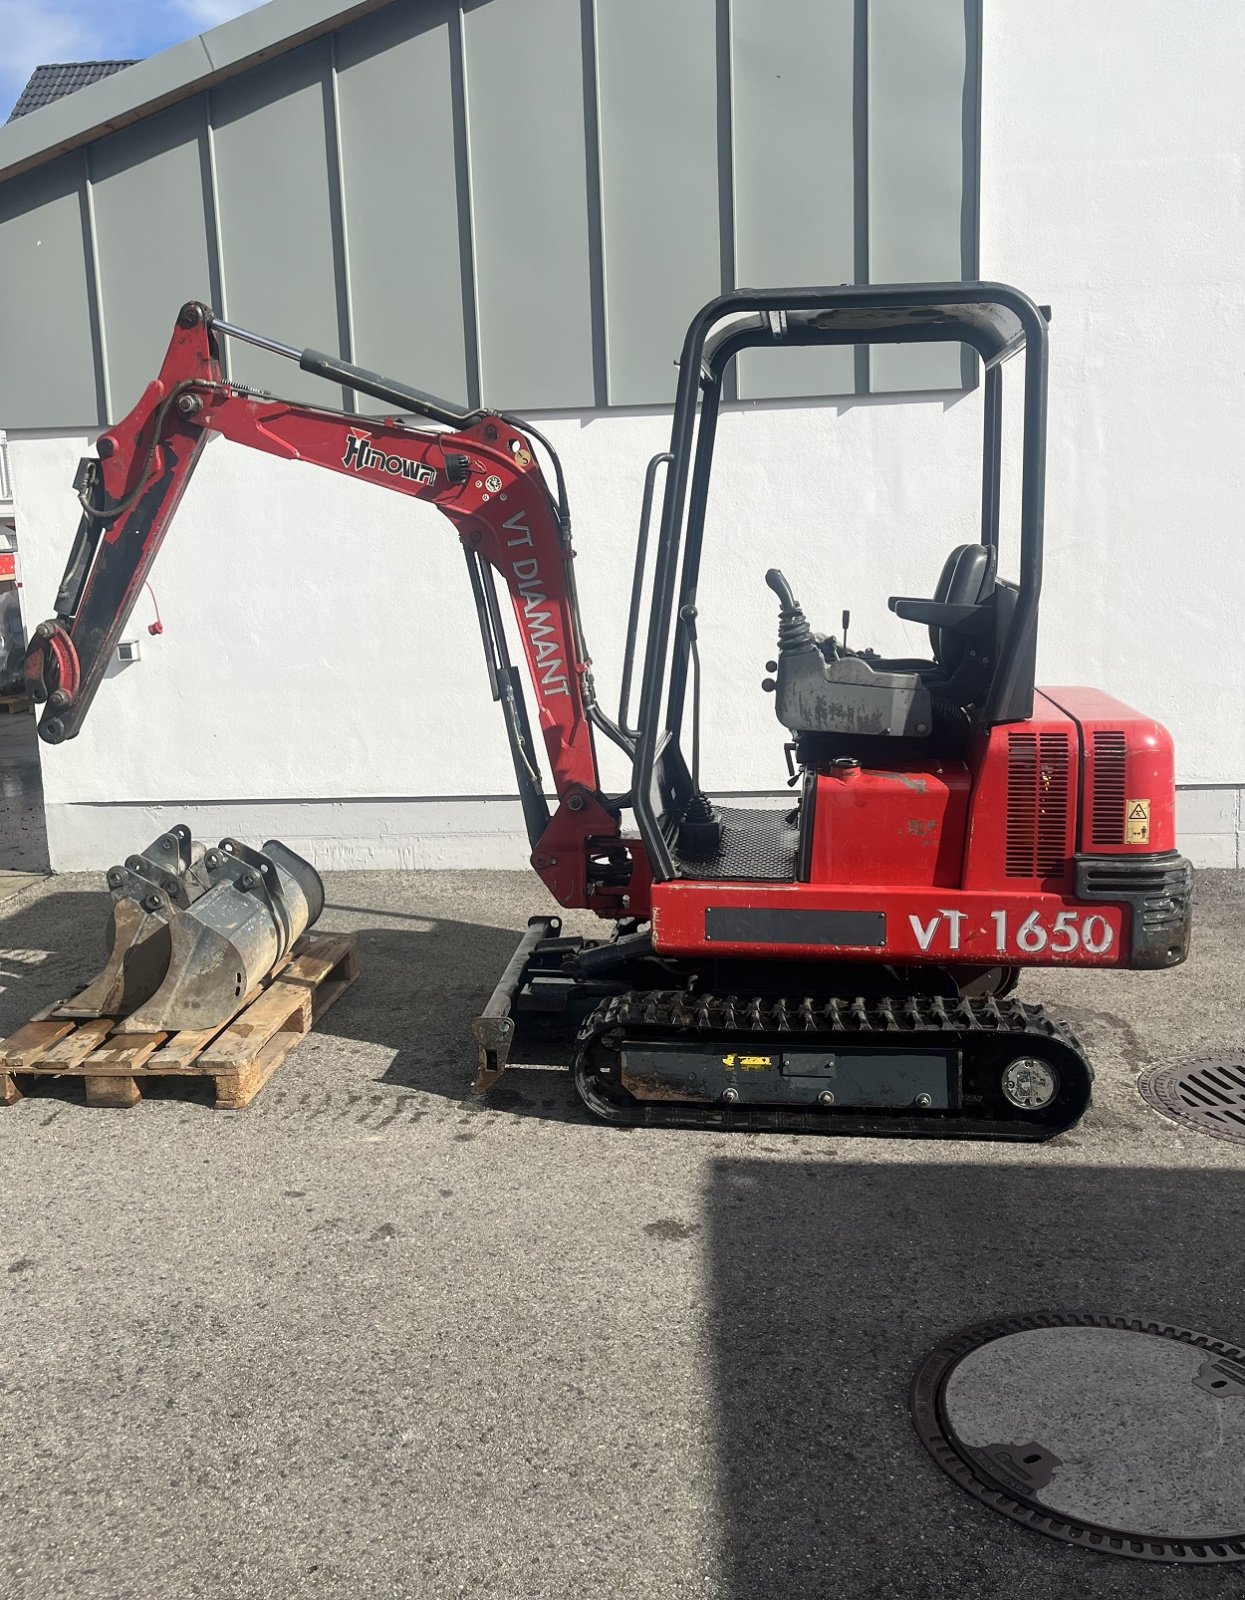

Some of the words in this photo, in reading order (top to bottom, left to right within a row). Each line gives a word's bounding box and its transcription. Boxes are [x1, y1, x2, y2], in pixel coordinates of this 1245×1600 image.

[502, 511, 534, 548] VT
[512, 557, 570, 697] DIAMANT
[908, 909, 968, 951] VT
[991, 910, 1114, 954] 1650
